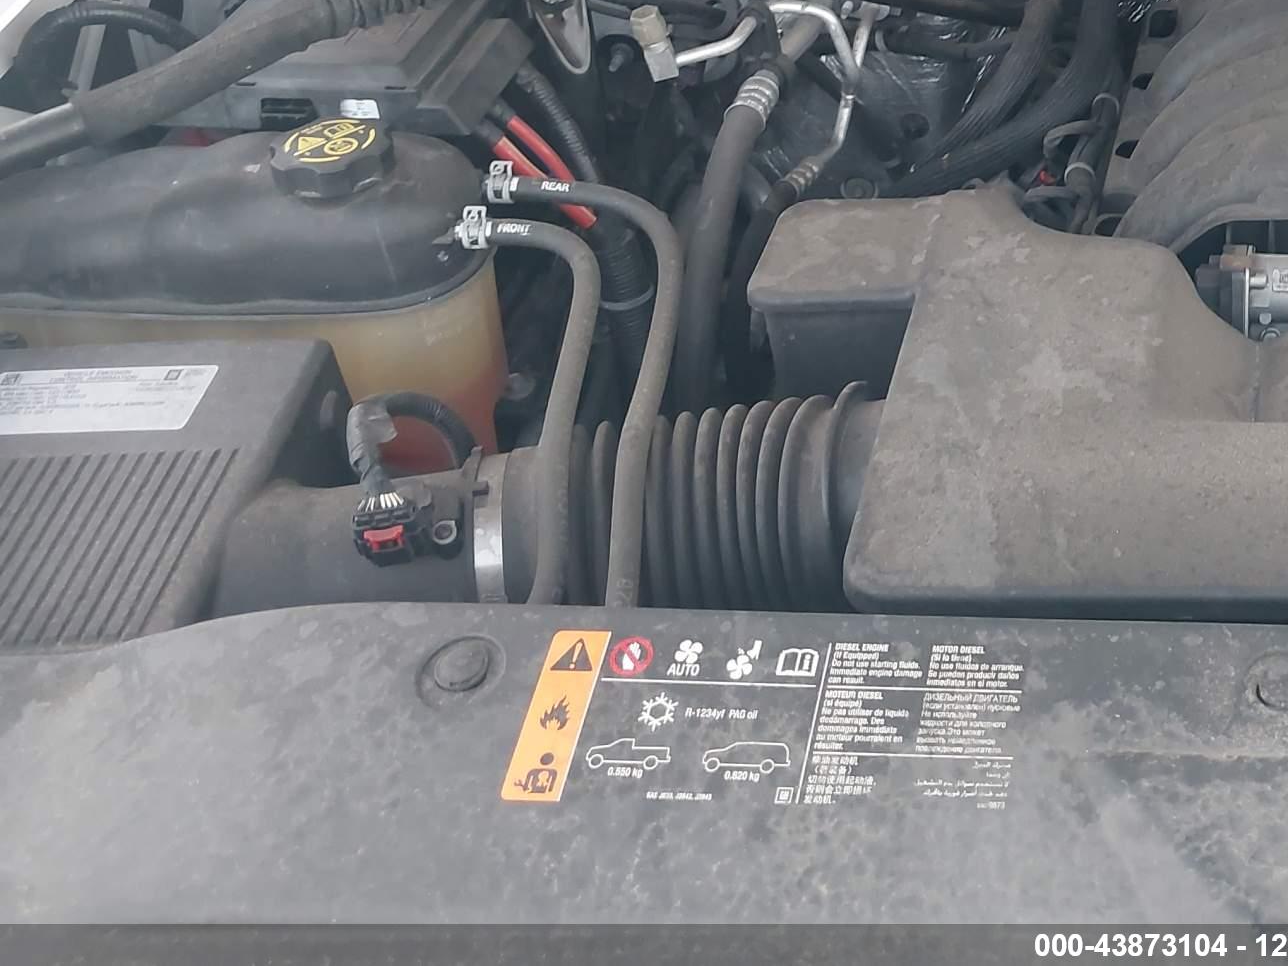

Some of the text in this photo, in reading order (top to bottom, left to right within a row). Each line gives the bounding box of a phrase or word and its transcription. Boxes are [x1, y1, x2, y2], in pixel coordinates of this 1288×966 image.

[541, 180, 570, 193] REAR
[497, 222, 531, 234] FRONT
[834, 642, 889, 652] DIESEL ENGINE
[932, 645, 985, 654] MOTOR DIESEL
[843, 651, 880, 660] Equipped)
[831, 659, 841, 667] Do
[870, 660, 898, 670] starting
[929, 662, 940, 670] No
[955, 663, 979, 671] fluidos
[980, 663, 990, 671] de
[667, 663, 700, 677] AUTO
[829, 668, 923, 679] Immediate engine damage
[927, 670, 938, 678] Se
[938, 671, 966, 679] pueden
[997, 671, 1020, 680] daños
[842, 676, 865, 684] result.
[967, 680, 977, 688] en
[977, 679, 985, 688] el
[985, 680, 1009, 688] motor.
[824, 690, 884, 700] MOTEUR DIESEL
[924, 692, 1018, 704] ДИЗЕЛЬНЫЙ ДВИГАТЕЛЬ
[685, 707, 758, 720] R-1234yf PAG oil
[821, 707, 832, 716] Ne
[832, 708, 847, 718] pas
[873, 709, 884, 717] de
[870, 716, 885, 725] Des
[818, 724, 858, 734] dommages
[893, 736, 904, 744] en
[632, 768, 644, 779] kg
[749, 772, 760, 783] kg
